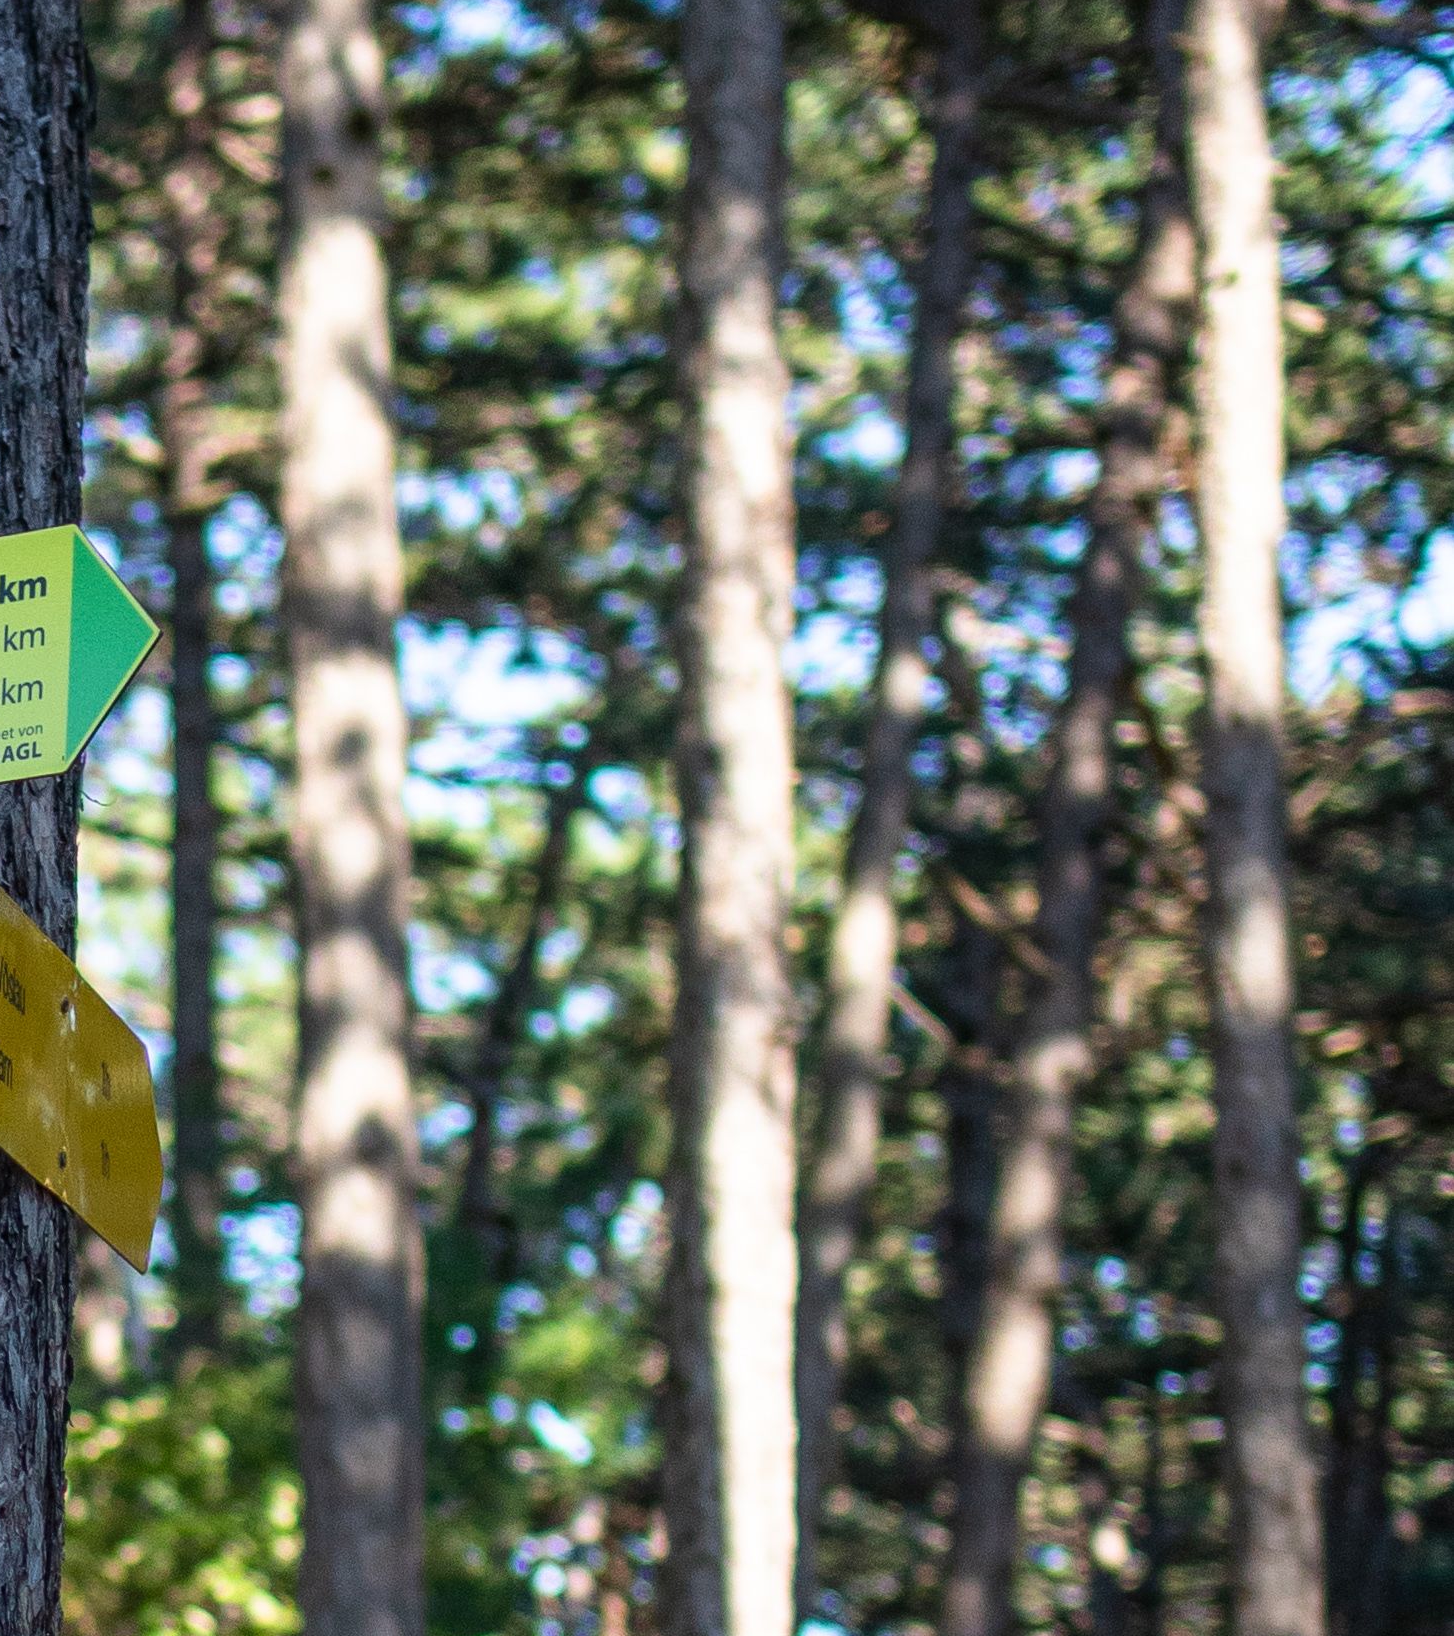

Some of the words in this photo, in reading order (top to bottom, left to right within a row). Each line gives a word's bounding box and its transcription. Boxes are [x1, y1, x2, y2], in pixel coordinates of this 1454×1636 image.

[3, 624, 46, 653] km
[1, 677, 43, 706] km
[18, 724, 44, 737] von
